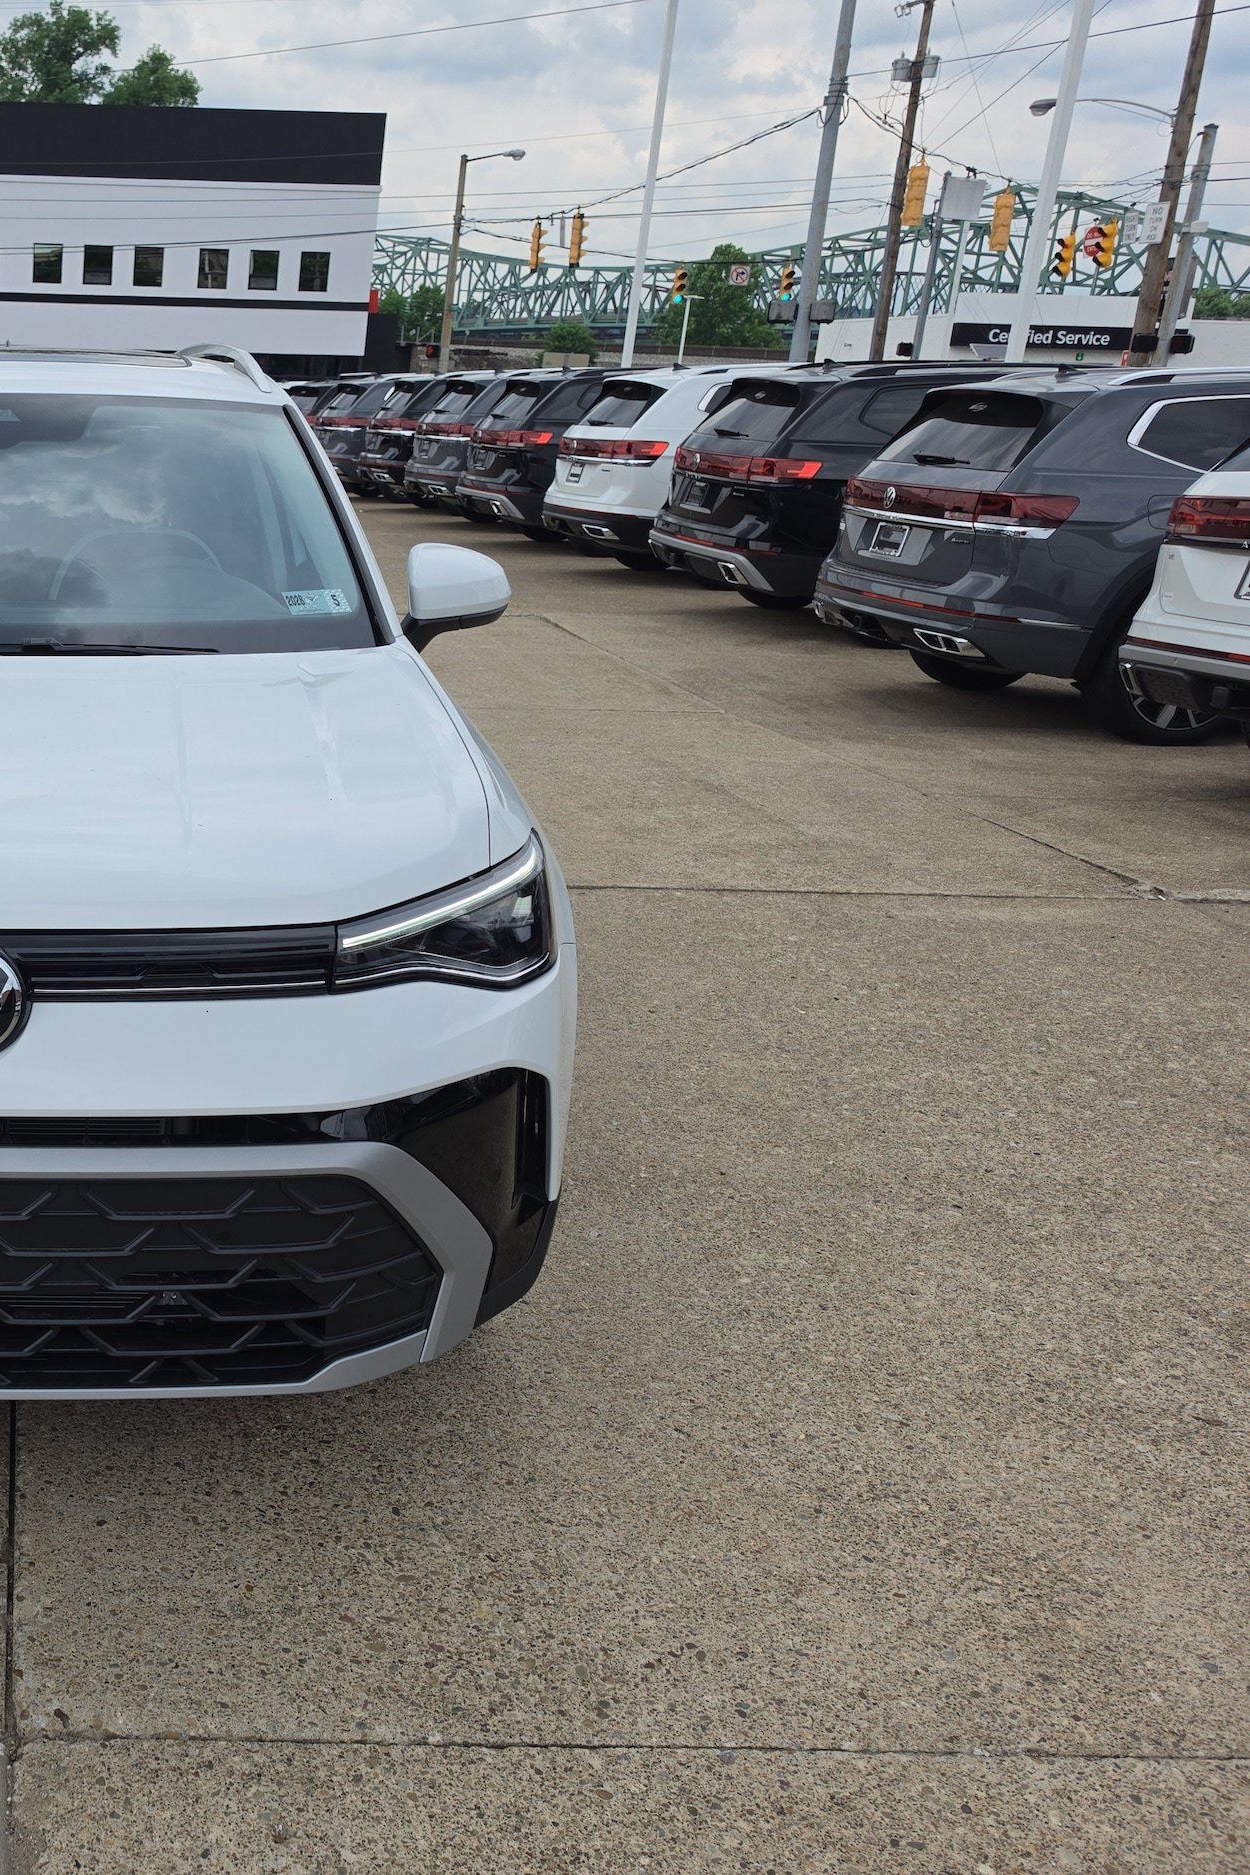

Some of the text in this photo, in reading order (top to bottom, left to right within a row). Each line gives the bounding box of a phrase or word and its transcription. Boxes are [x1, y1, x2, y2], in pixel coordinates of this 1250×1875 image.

[1152, 206, 1163, 215] NO
[1149, 215, 1163, 224] TURN
[1150, 225, 1158, 233] ON
[1146, 233, 1158, 241] RED
[1055, 330, 1110, 346] Service
[330, 594, 341, 607] 5
